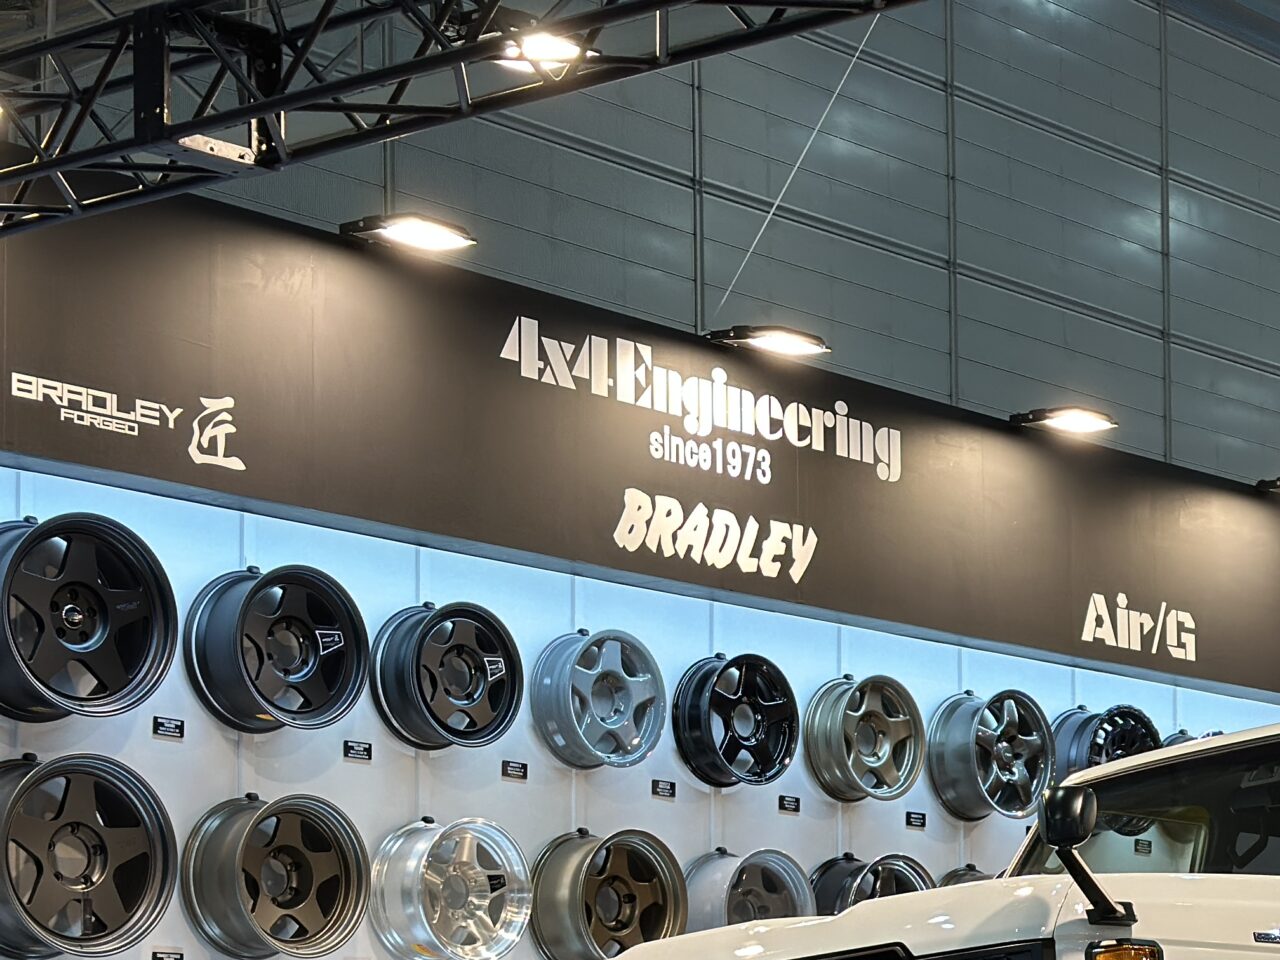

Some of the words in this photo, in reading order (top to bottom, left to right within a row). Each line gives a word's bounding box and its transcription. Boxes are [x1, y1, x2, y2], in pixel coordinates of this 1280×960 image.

[11, 371, 184, 429] BRADLEY
[60, 407, 139, 436] FORGED
[188, 396, 247, 471] 匠
[500, 315, 902, 482] 4x4Engineering
[613, 487, 818, 584] BRADLEY
[1081, 592, 1196, 661] Air/G
